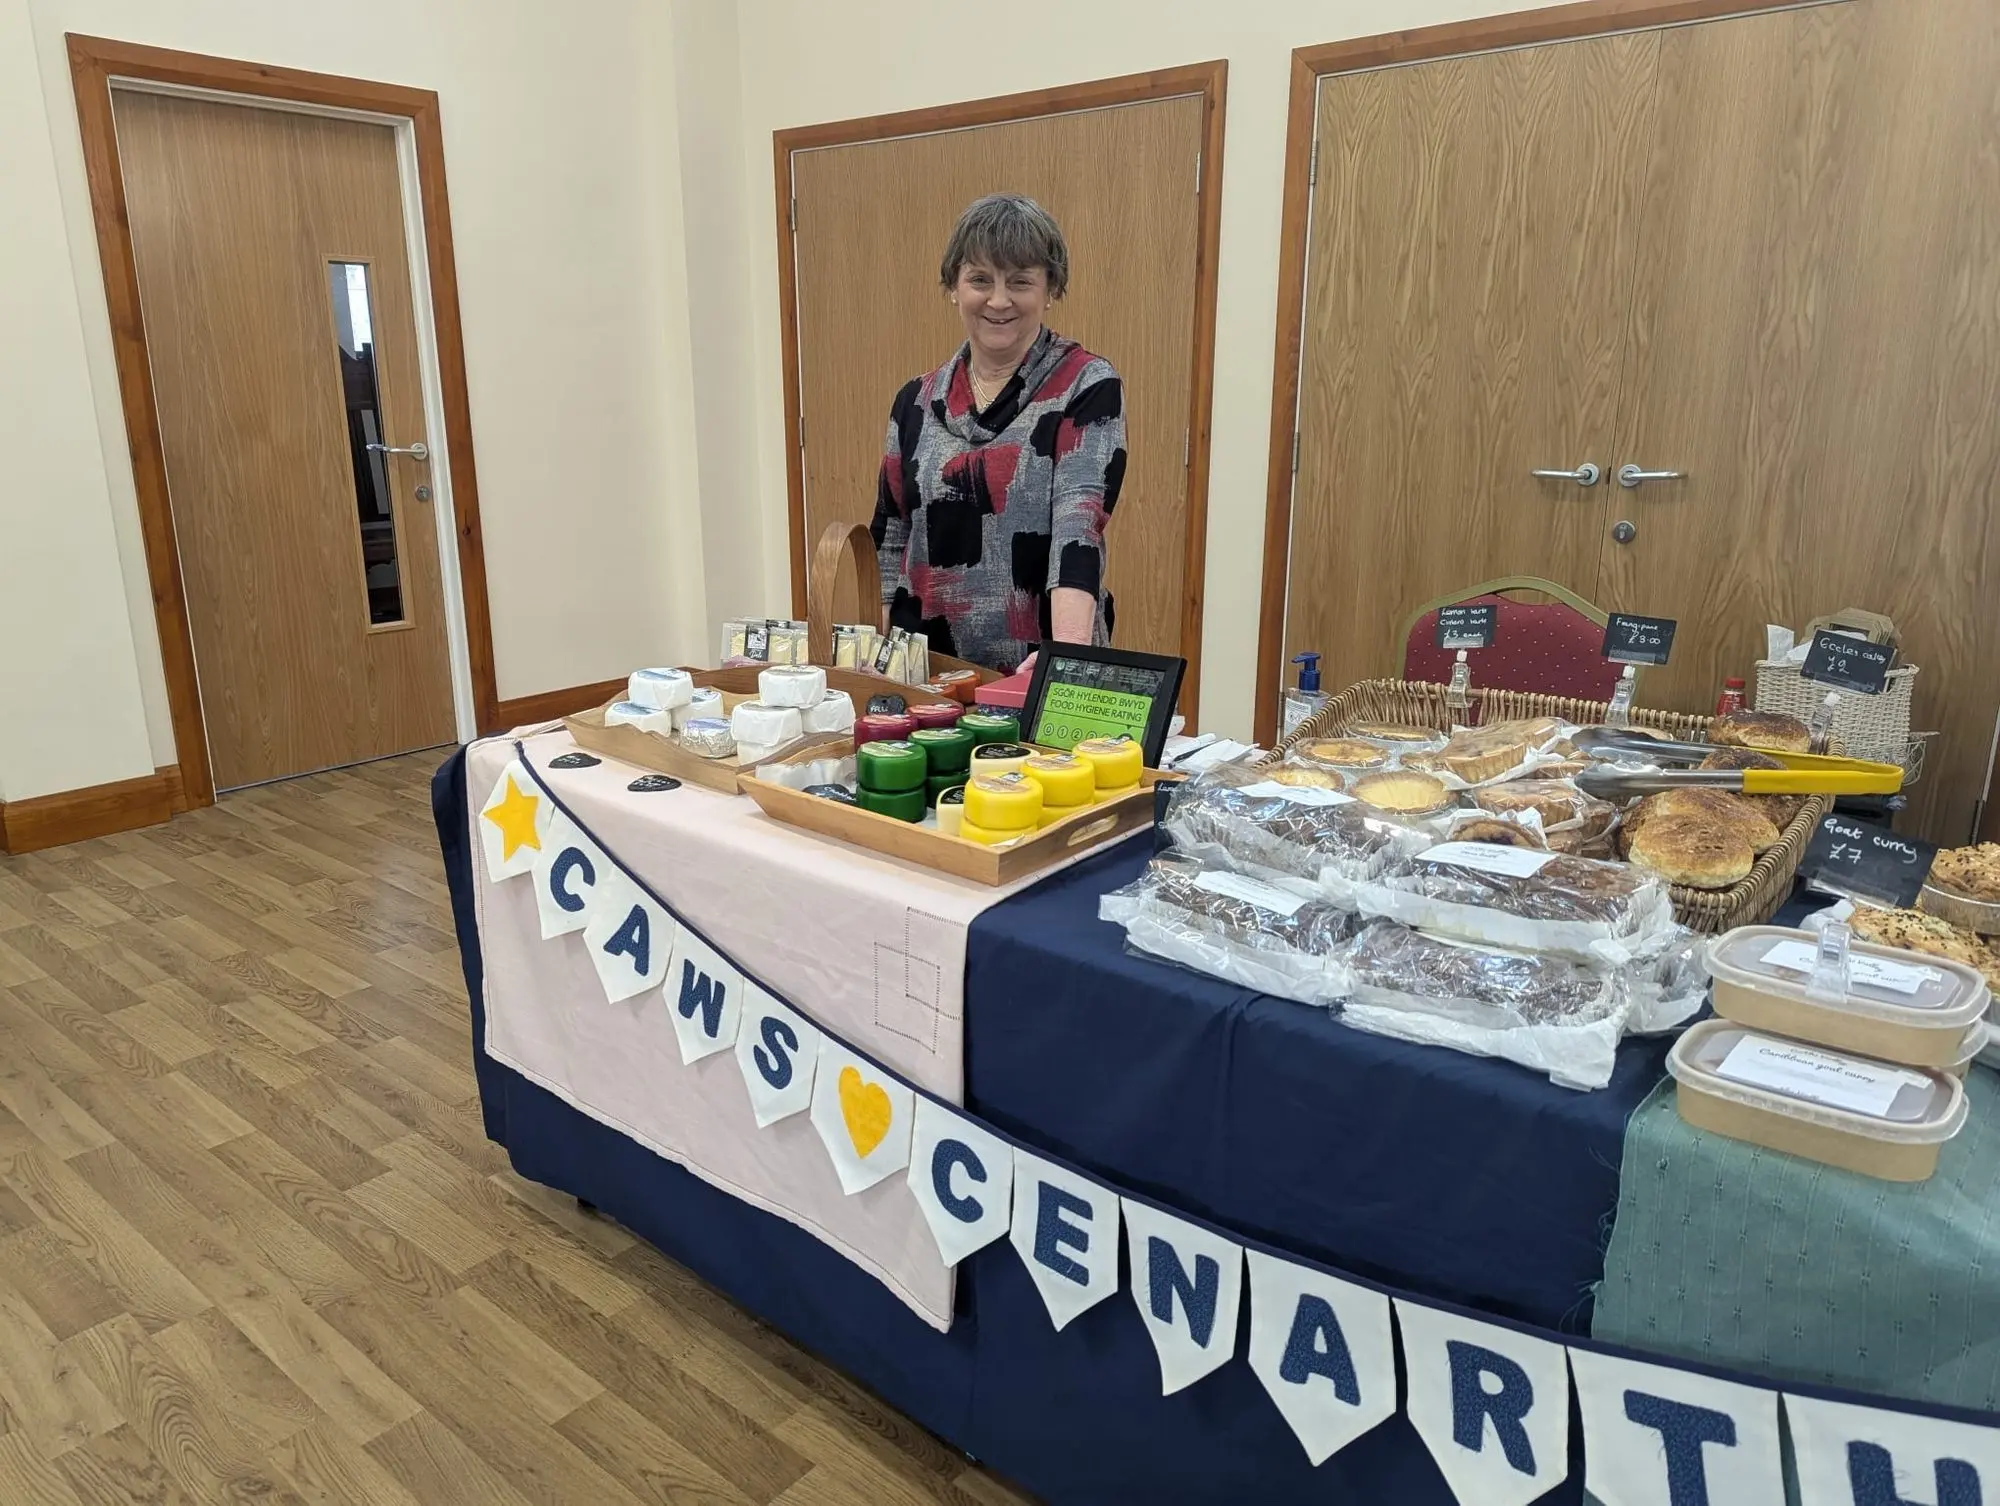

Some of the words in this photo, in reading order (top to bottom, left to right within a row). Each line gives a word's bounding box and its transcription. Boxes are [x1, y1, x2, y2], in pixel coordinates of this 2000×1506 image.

[1819, 637, 1859, 657] Eccles
[1050, 698, 1075, 711] FOOD
[1075, 701, 1112, 717] HYGIENE
[1112, 708, 1143, 723] RATING
[1076, 690, 1118, 706] HYLENDID
[1118, 699, 1147, 711] BWYD
[1823, 818, 1864, 840] Goat
[1872, 836, 1918, 865] curry
[1828, 842, 1863, 865] £7
[550, 846, 799, 1091] CAWS
[1758, 1047, 1815, 1067] Caribbean
[1844, 1069, 1877, 1084] curry
